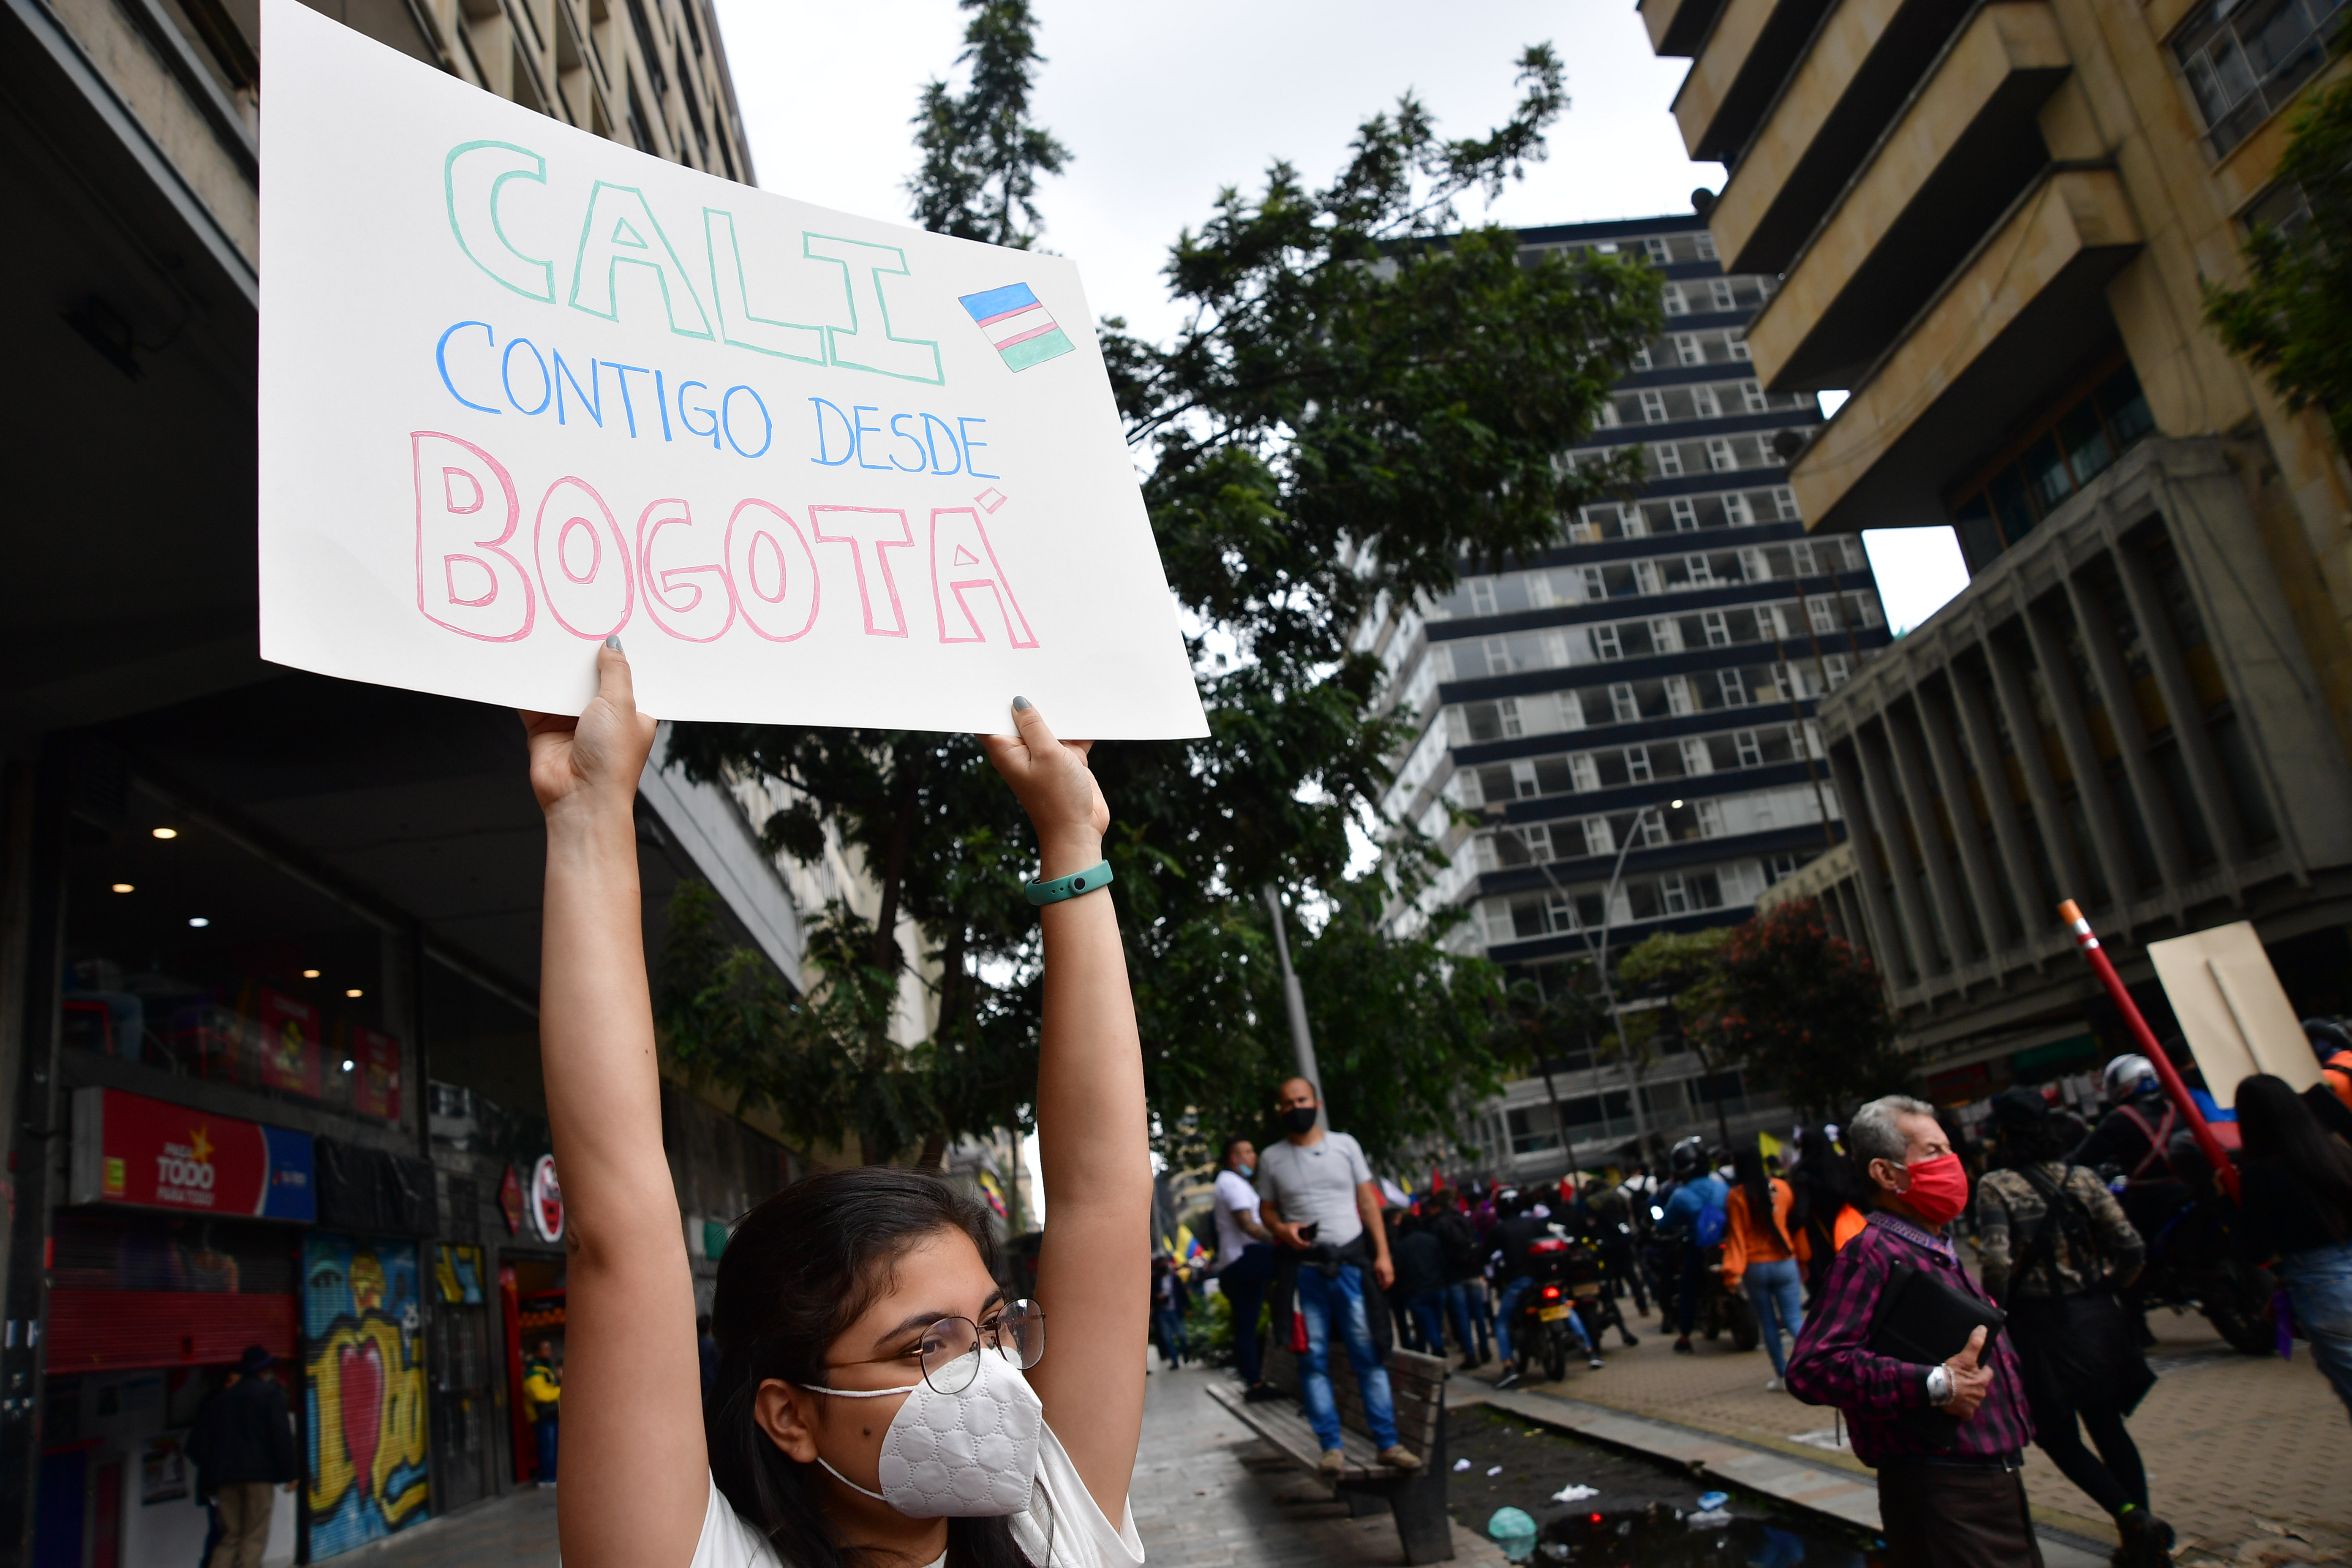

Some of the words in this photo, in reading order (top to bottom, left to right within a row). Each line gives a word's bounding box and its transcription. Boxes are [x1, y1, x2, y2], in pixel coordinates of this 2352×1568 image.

[444, 140, 945, 386] CALI
[436, 320, 772, 458] CONTIGO
[808, 397, 1000, 479] DESDE
[409, 430, 1040, 649] BOGOTÁ
[155, 1156, 215, 1189] TODO
